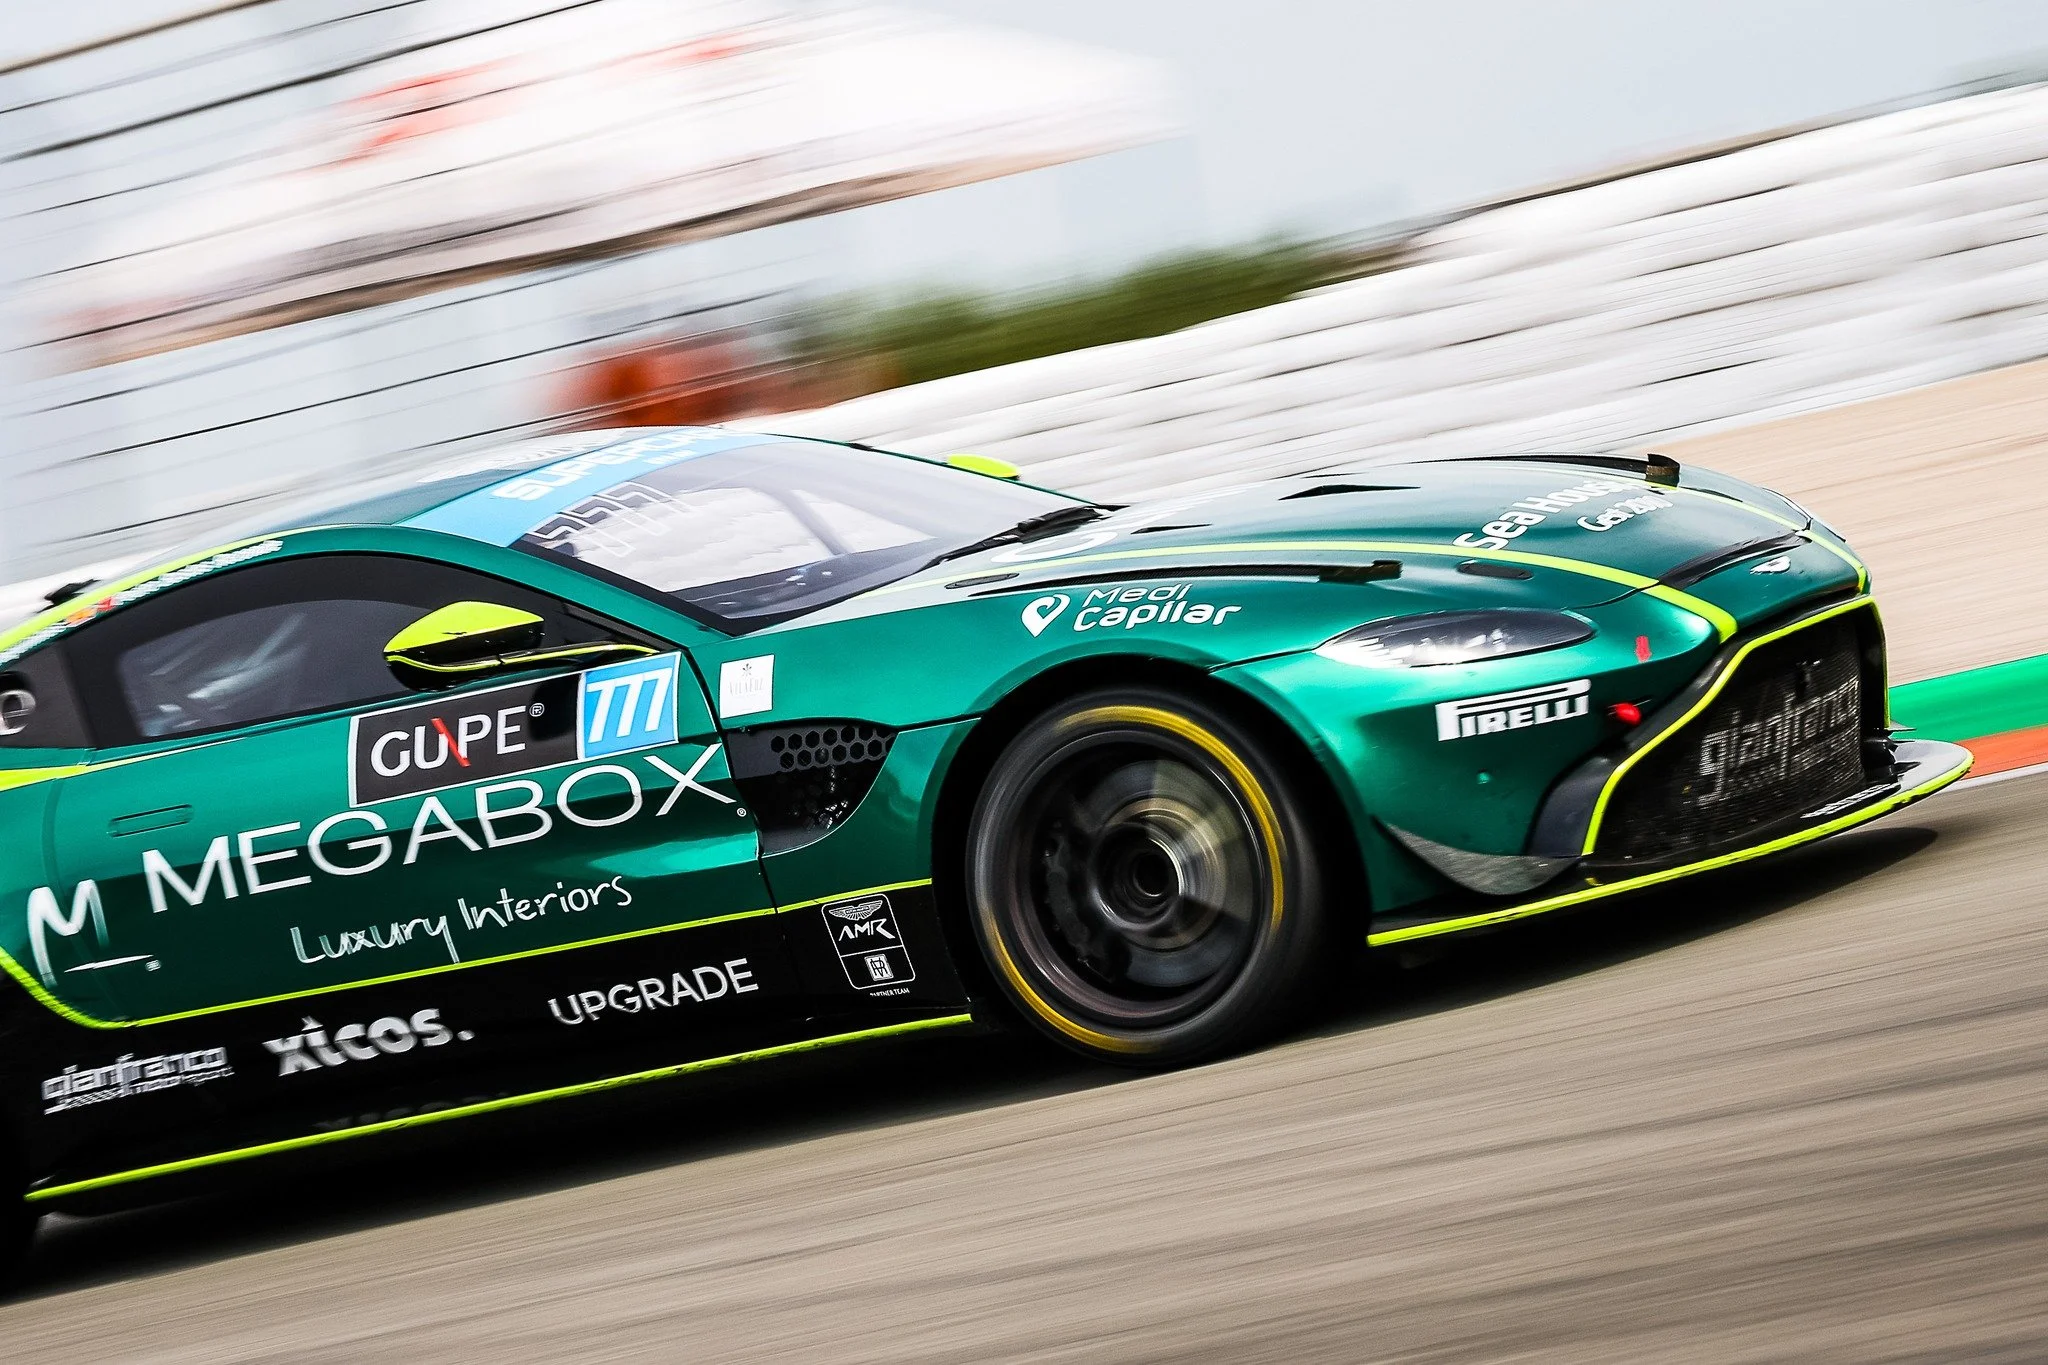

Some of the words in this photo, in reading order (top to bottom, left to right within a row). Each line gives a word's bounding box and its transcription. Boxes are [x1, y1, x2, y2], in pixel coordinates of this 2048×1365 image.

[586, 667, 674, 745] 777
[1435, 678, 1592, 742] PIRELLI
[290, 916, 462, 963] Luxury
[458, 875, 633, 930] Interiors
[838, 918, 896, 941] AMR
[548, 957, 760, 1026] UPGRADE
